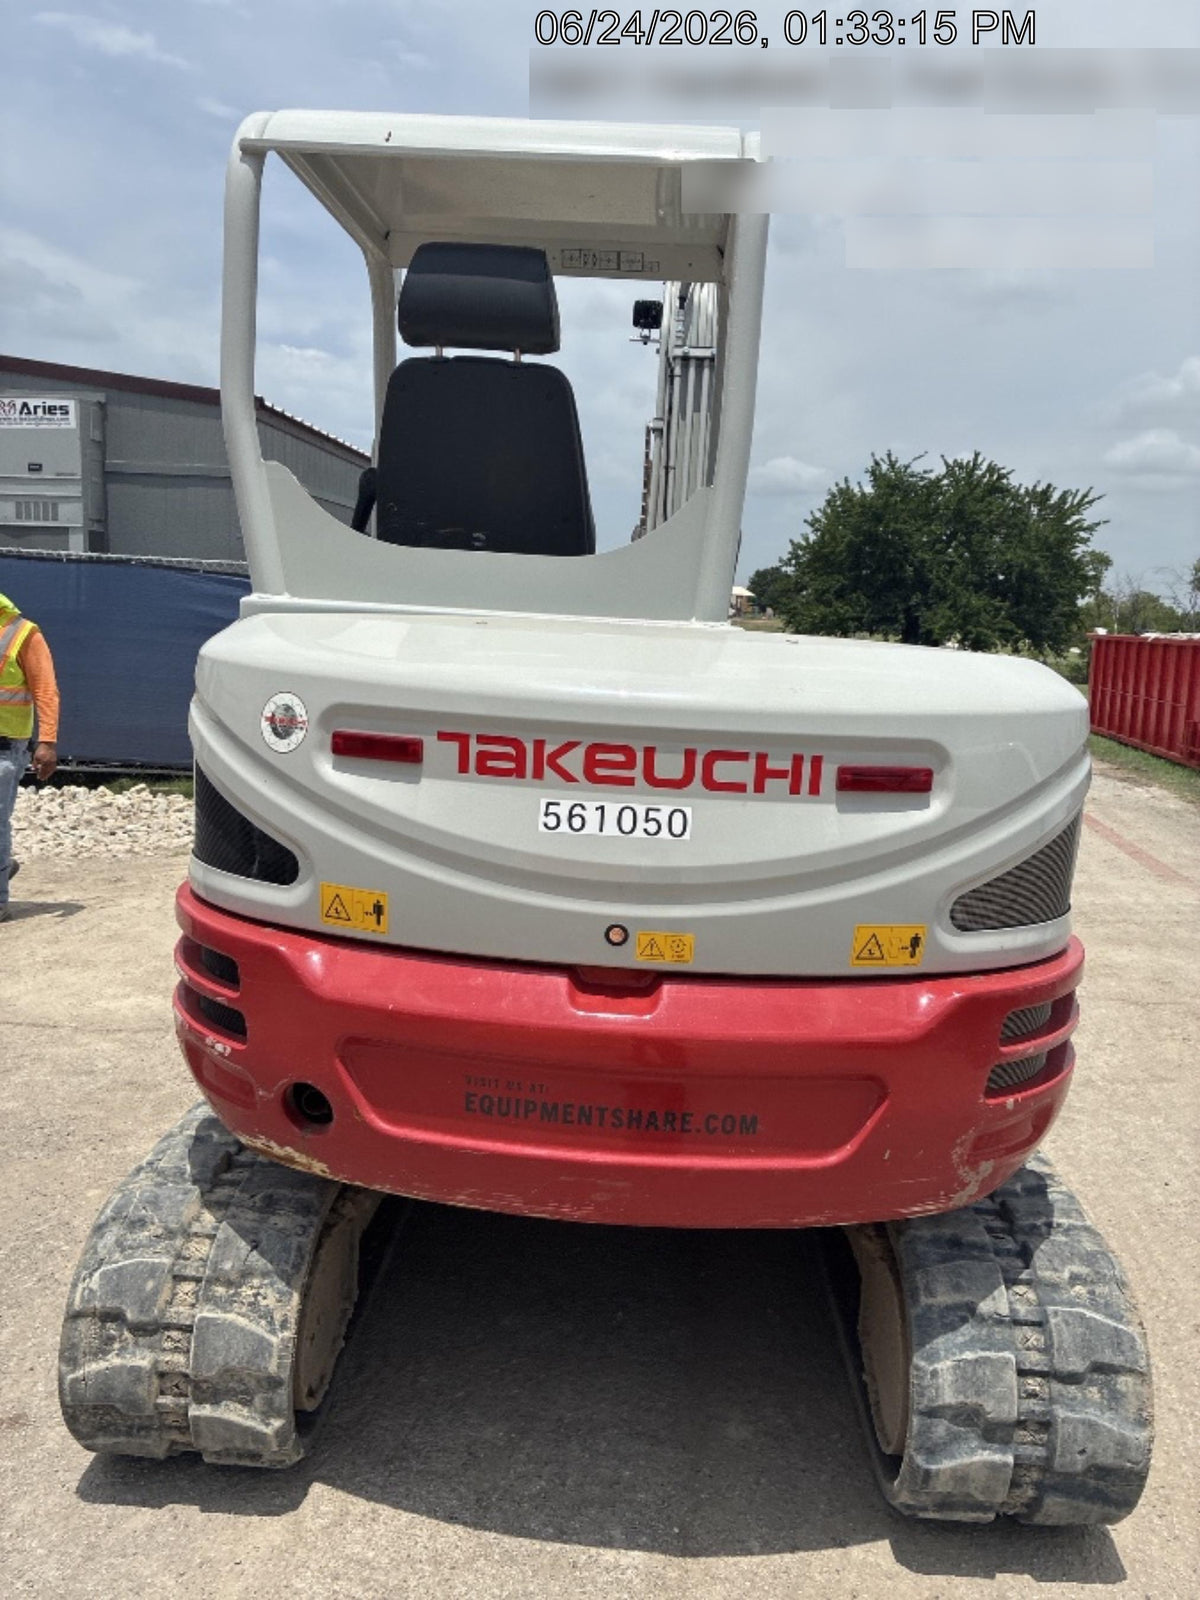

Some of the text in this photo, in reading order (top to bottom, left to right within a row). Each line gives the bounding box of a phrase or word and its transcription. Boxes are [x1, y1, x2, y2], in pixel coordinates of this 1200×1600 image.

[19, 401, 70, 416] Aries
[541, 801, 689, 839] 561050
[464, 1091, 758, 1135] EQUIPMENTSHARE.COM
